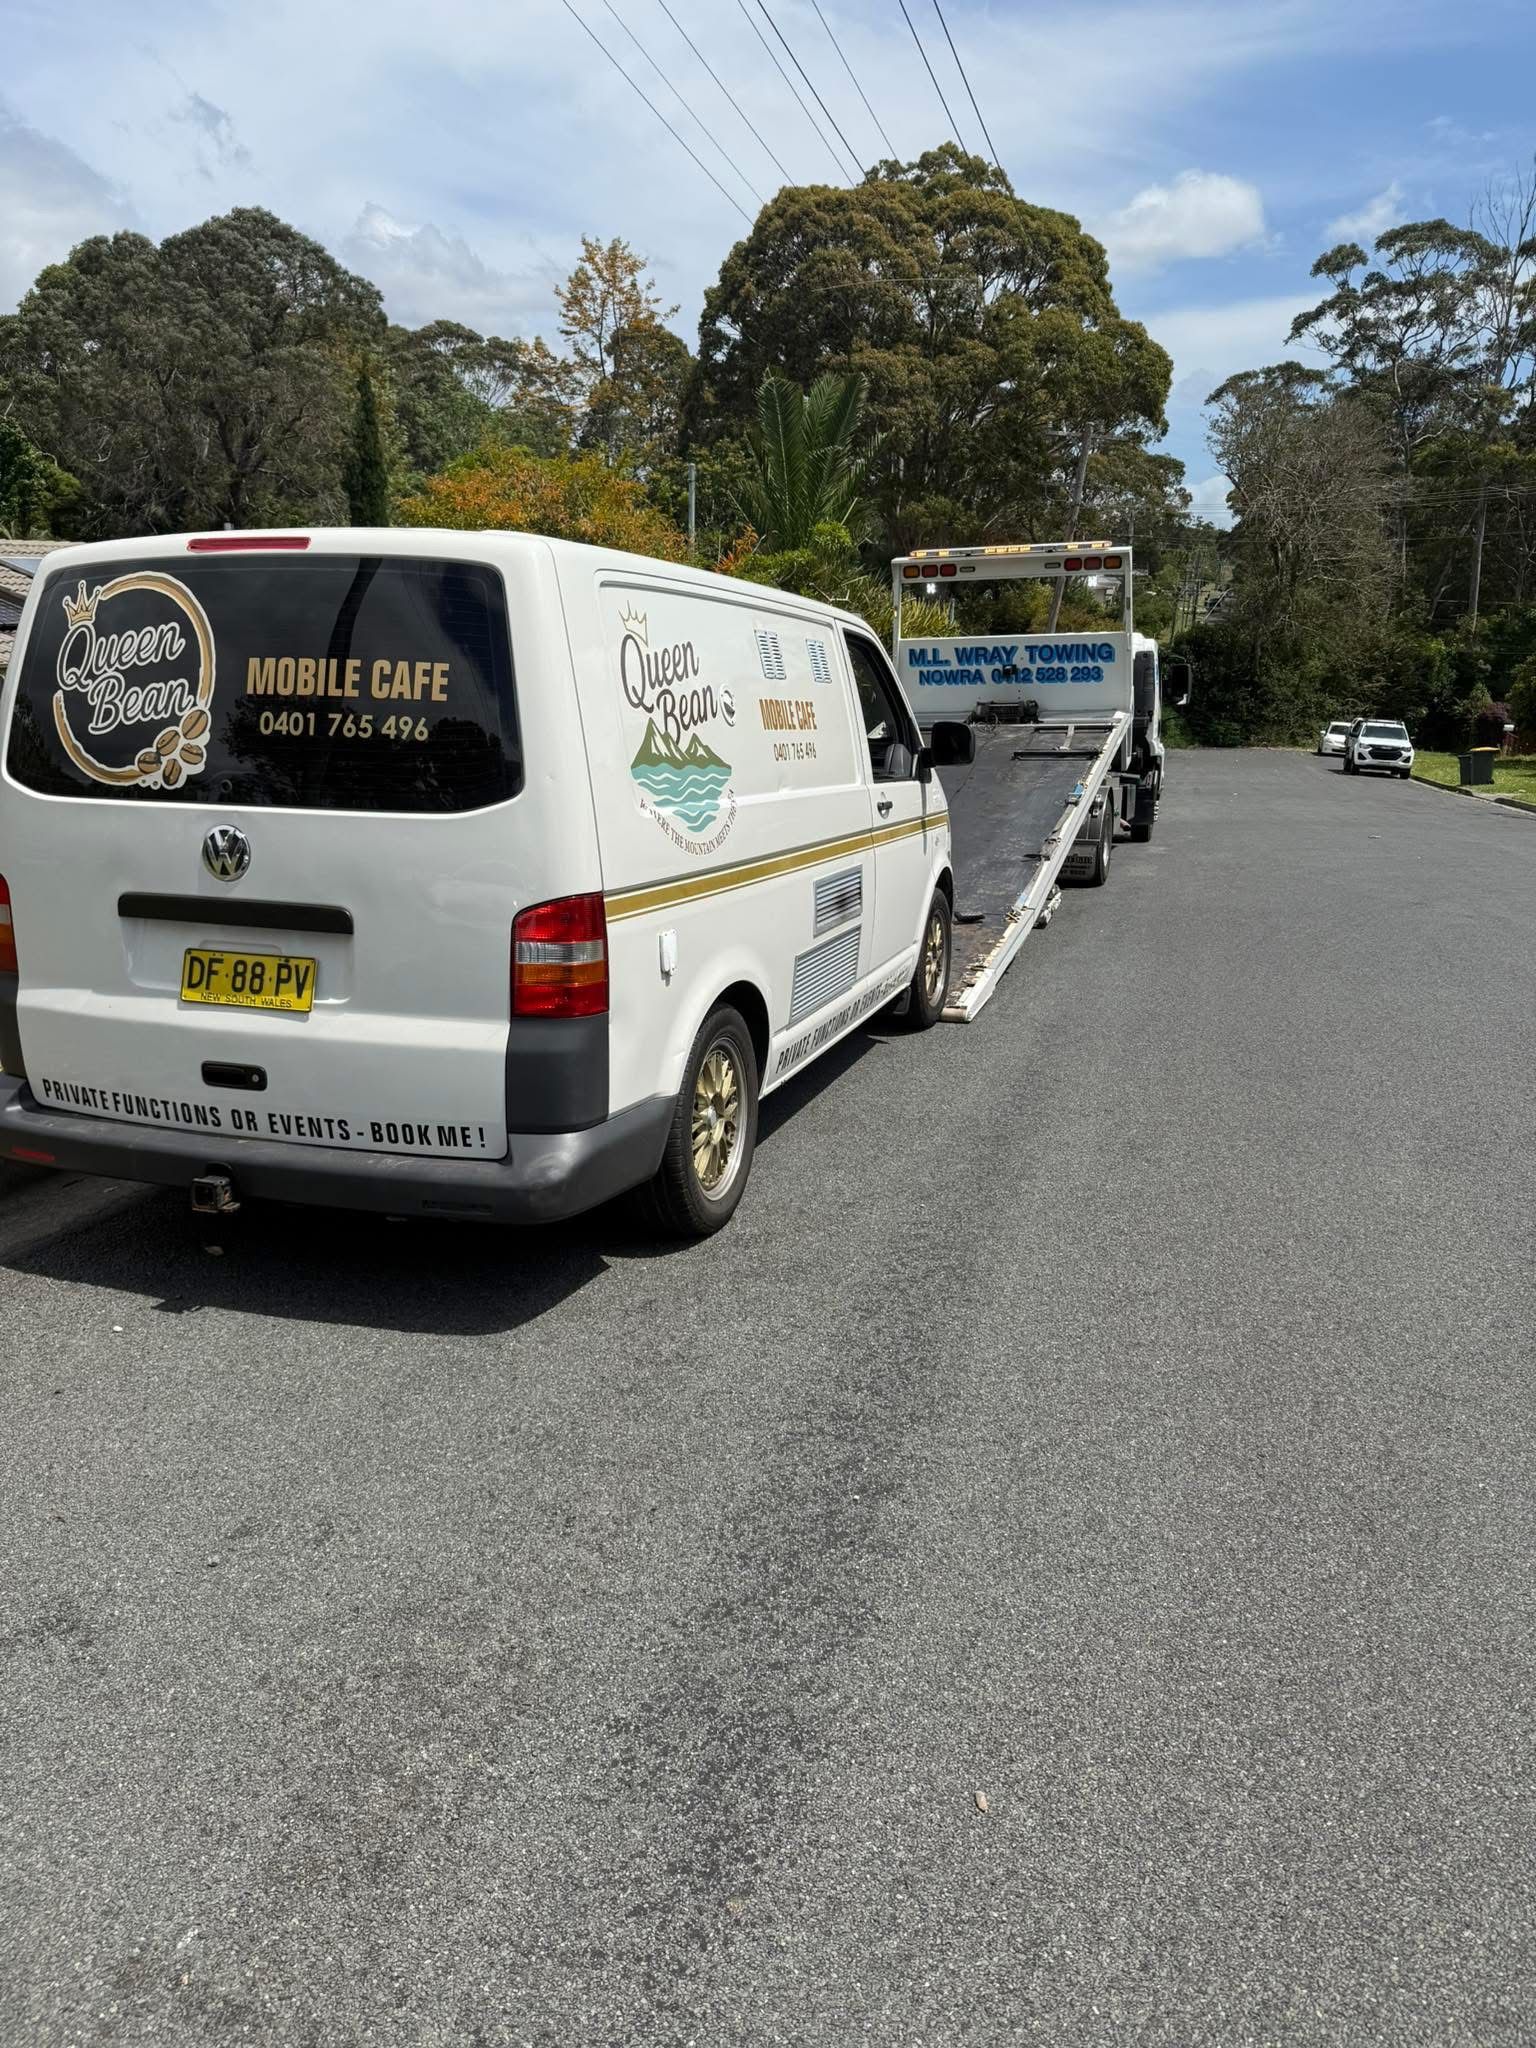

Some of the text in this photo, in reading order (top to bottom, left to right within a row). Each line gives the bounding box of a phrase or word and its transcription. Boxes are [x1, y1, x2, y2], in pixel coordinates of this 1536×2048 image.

[57, 621, 186, 692] Queen
[620, 633, 700, 714] Queen
[908, 642, 1115, 667] M.L. WRAY TOWING
[246, 657, 450, 702] MOBILE CAFE
[919, 665, 1104, 686] NOWRA 012 528 293
[88, 671, 194, 735] Bean
[656, 685, 718, 746] Bean
[759, 698, 817, 730] MOBILE CAFE
[259, 711, 429, 741] 0401 765 496
[774, 741, 817, 761] 0401 765 496
[671, 827, 684, 849] THE
[684, 839, 716, 856] MOUNTAIN
[714, 820, 731, 849] MEETS
[201, 992, 292, 1009] NEW SOUTH WALES
[776, 1032, 811, 1074] PRIVATE
[42, 1078, 109, 1110] PRIVATE
[112, 1092, 222, 1127] FUNCTIONS
[231, 1108, 259, 1132] OR
[267, 1113, 350, 1140] EVENTS
[370, 1121, 432, 1146] BOOK
